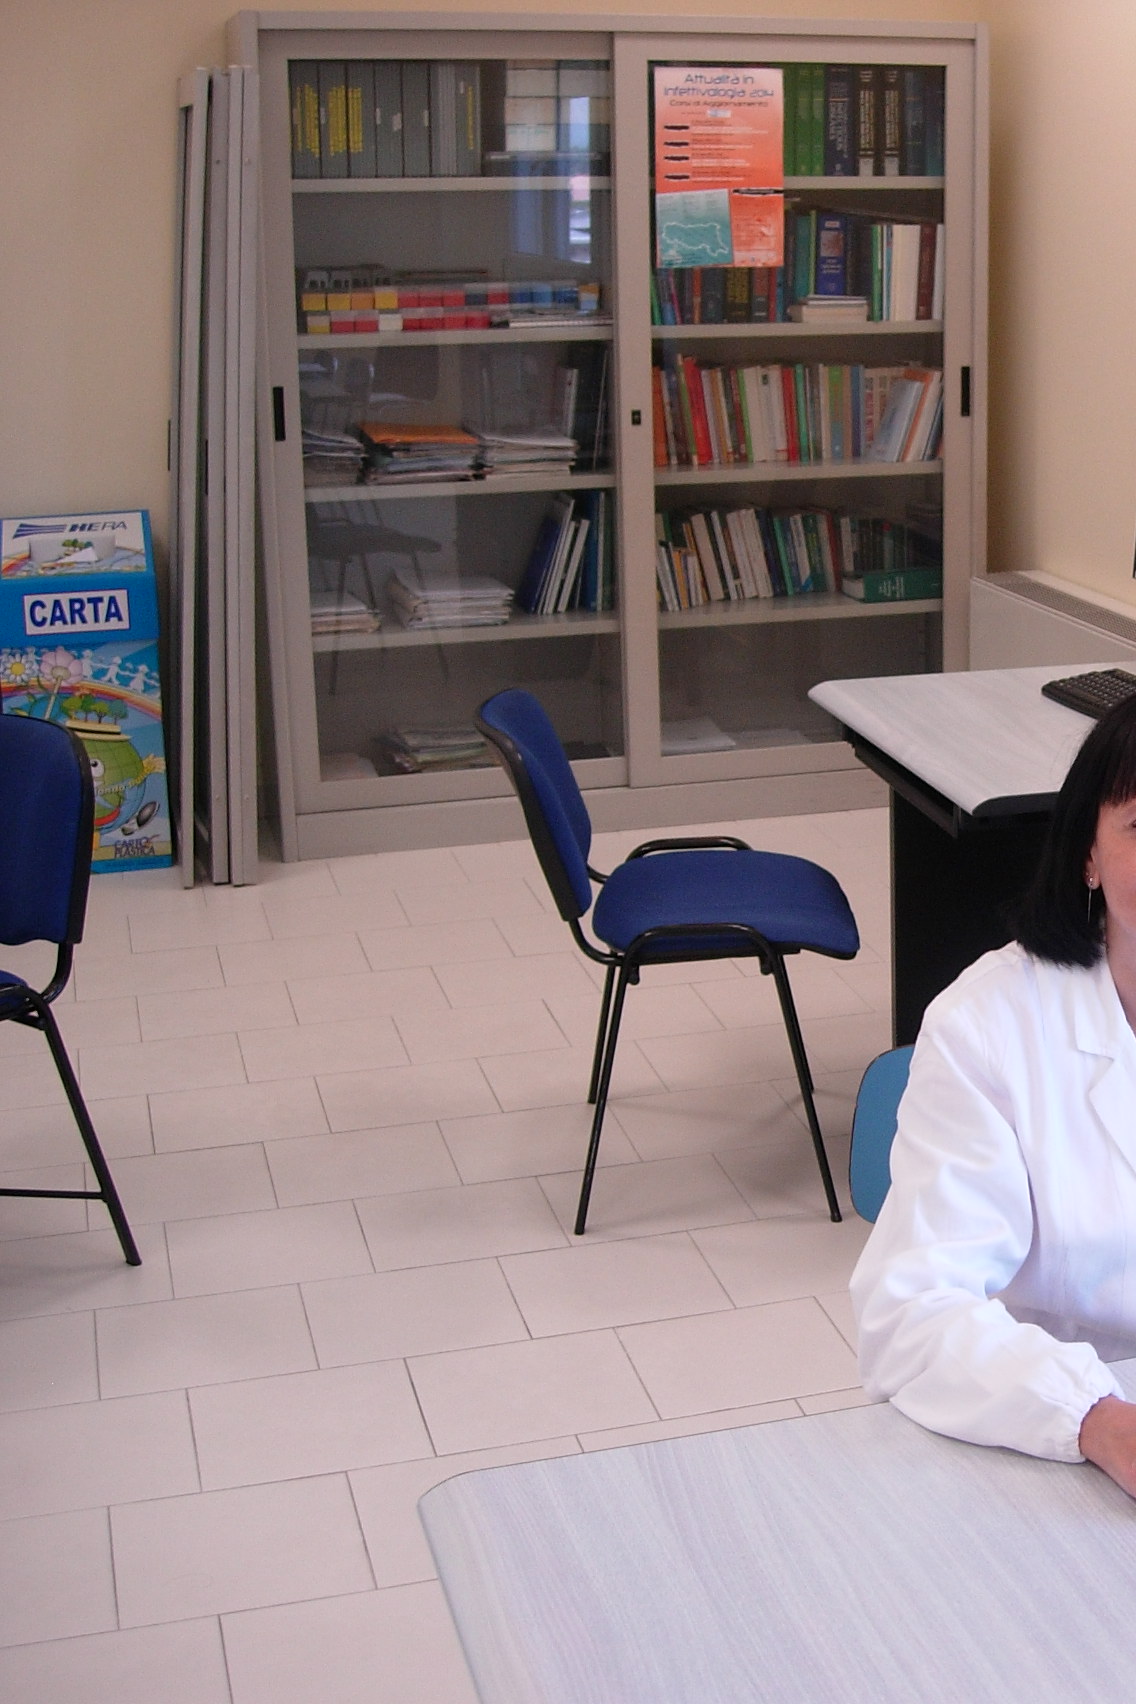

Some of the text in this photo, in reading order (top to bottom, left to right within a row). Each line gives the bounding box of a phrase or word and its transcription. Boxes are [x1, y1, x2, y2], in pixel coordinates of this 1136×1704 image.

[743, 75, 754, 84] in
[664, 86, 745, 99] Infettivologia
[69, 521, 127, 532] HERA
[29, 595, 124, 627] CARTA
